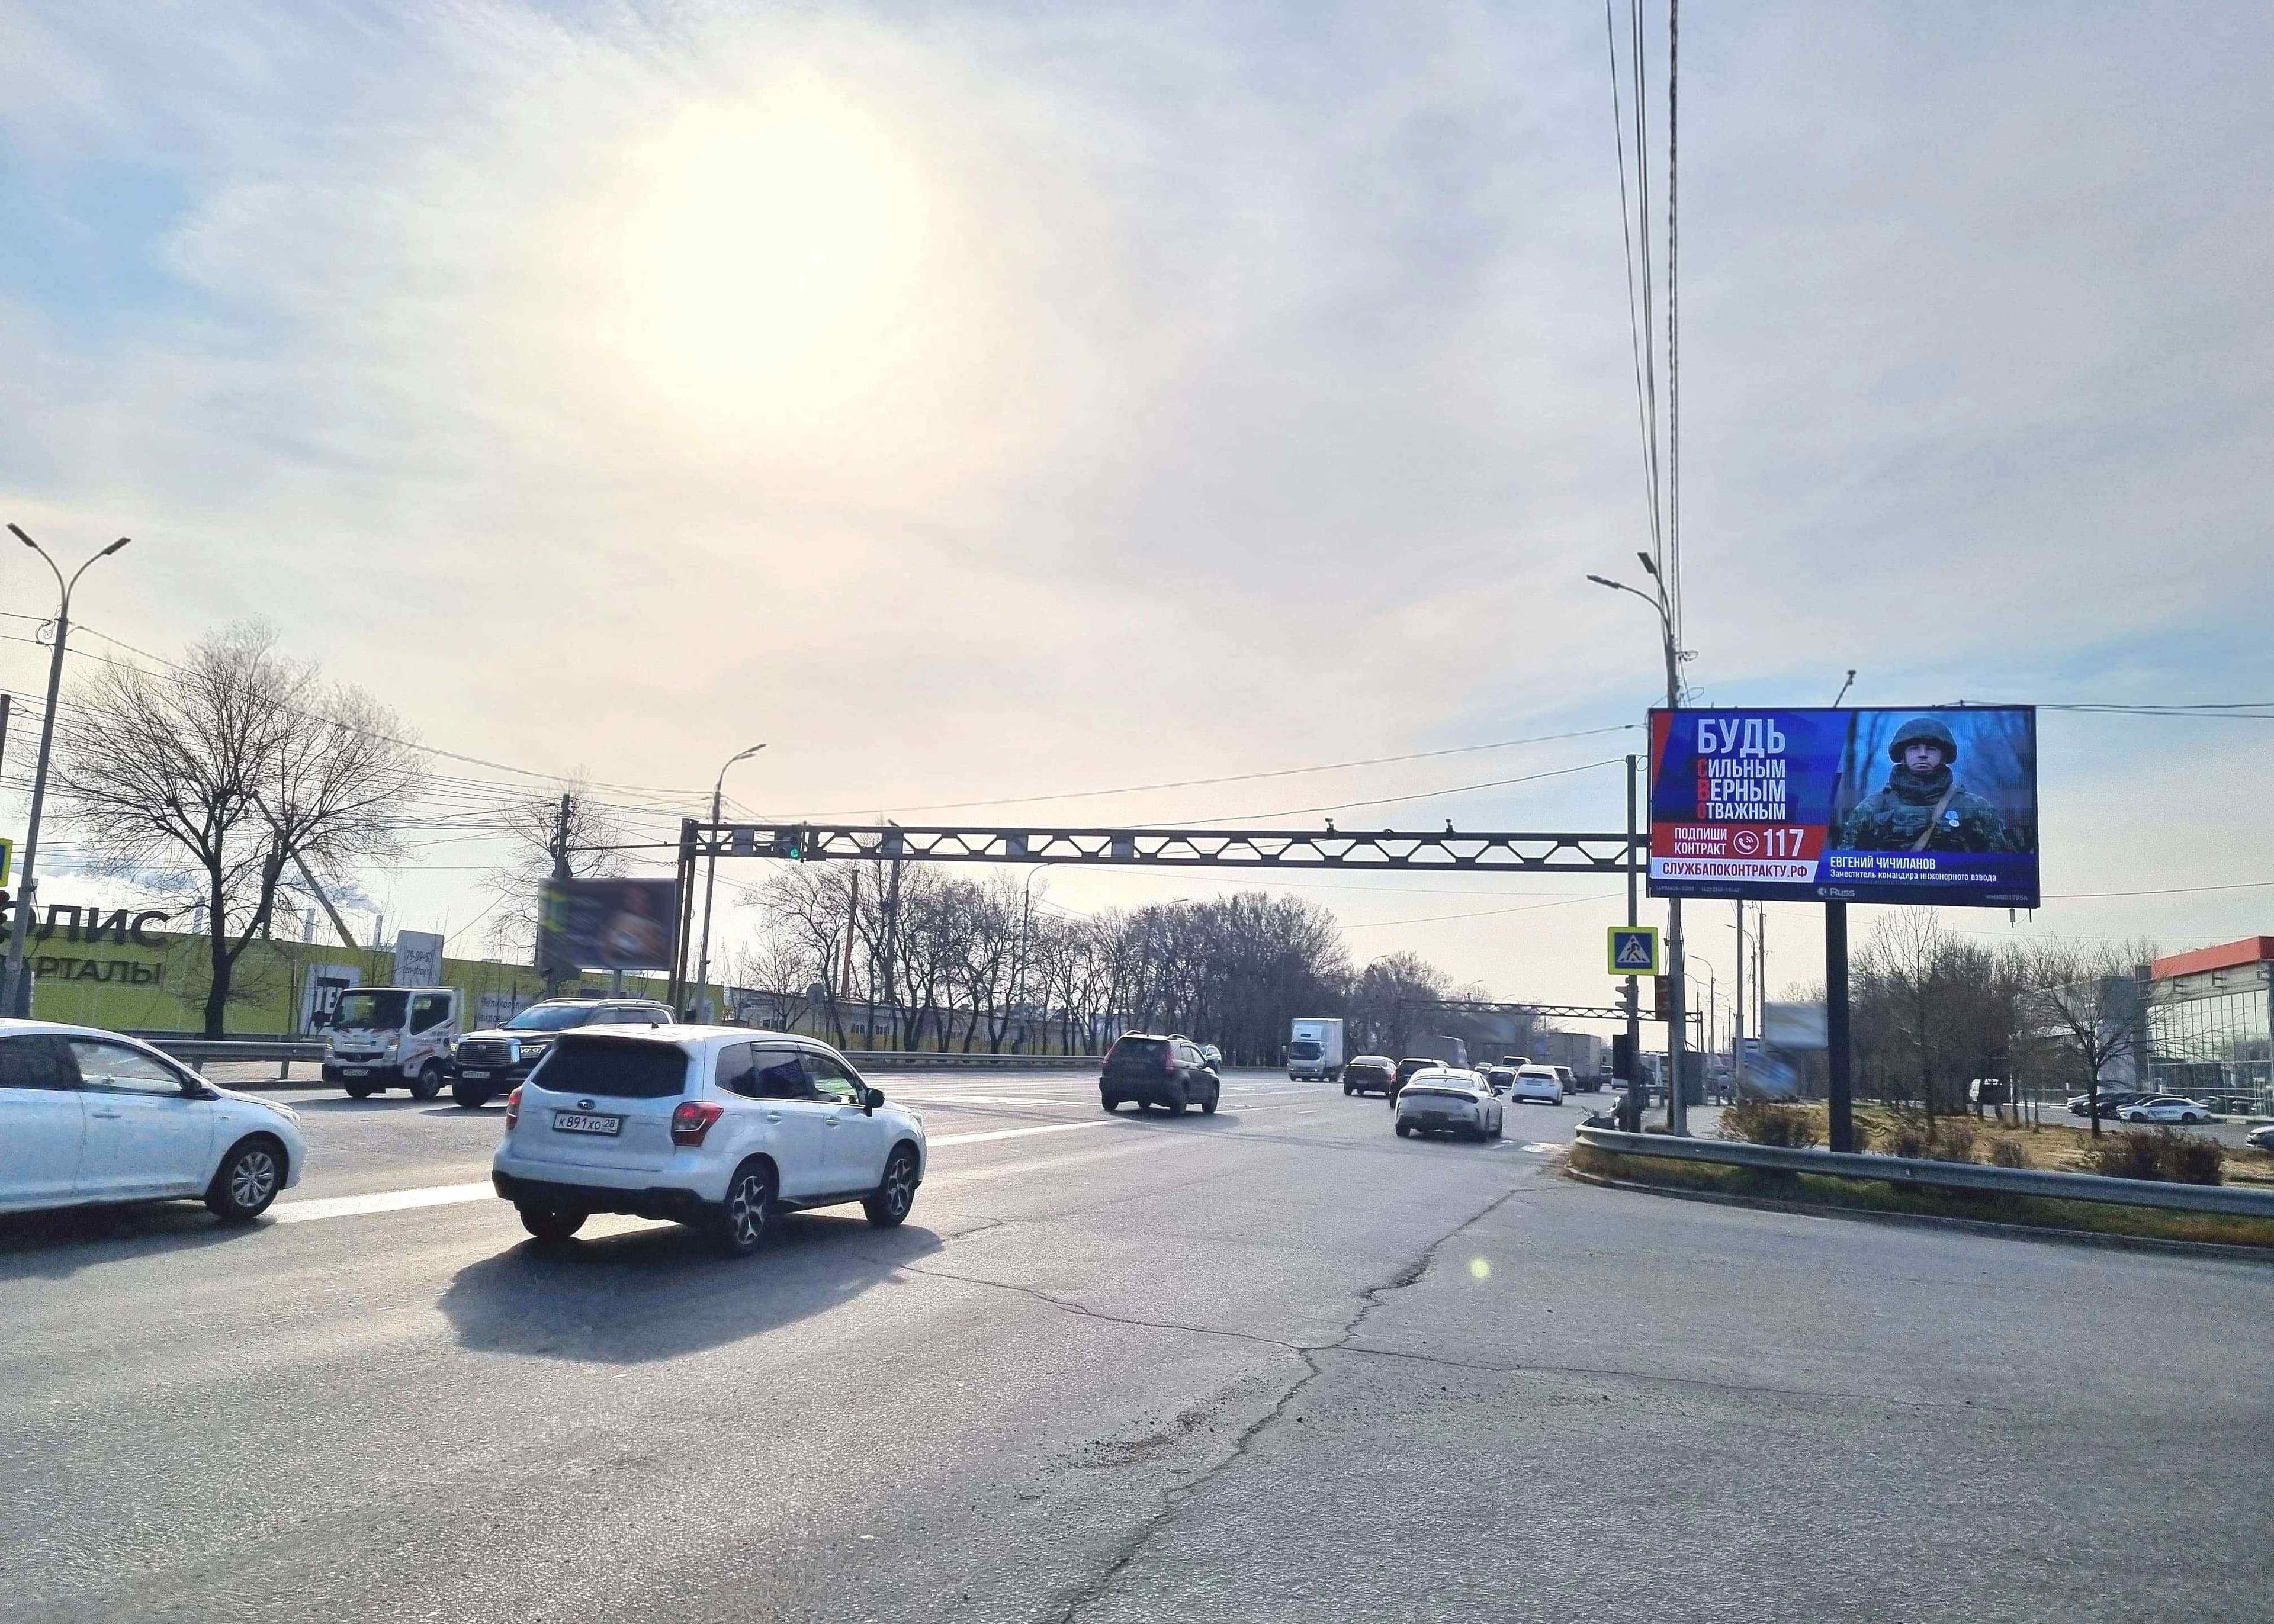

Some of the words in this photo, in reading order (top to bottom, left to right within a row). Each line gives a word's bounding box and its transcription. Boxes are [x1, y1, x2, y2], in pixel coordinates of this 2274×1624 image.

[1698, 719, 1785, 758] БУДЬ
[1697, 758, 1785, 778] СИЛЬНЫМ
[1697, 779, 1785, 802] ВЕРНЫМ
[1697, 802, 1785, 820] ОТВАЖНЫМ
[1675, 828, 1727, 841] ПОДПИШИ
[1674, 842, 1727, 856] КОНТРАКТ
[1764, 829, 1804, 857] 117
[1663, 862, 1808, 878] СЛУЖБАПОКОНТРАКТУ.РФ
[1830, 856, 1874, 868] ЕВГЕНИЙ
[1830, 869, 1877, 879] Заместитель
[1878, 872, 1918, 880] командира
[1920, 873, 1968, 882] инженерного
[1971, 874, 1997, 882] взвода
[1830, 887, 1855, 897] Russ
